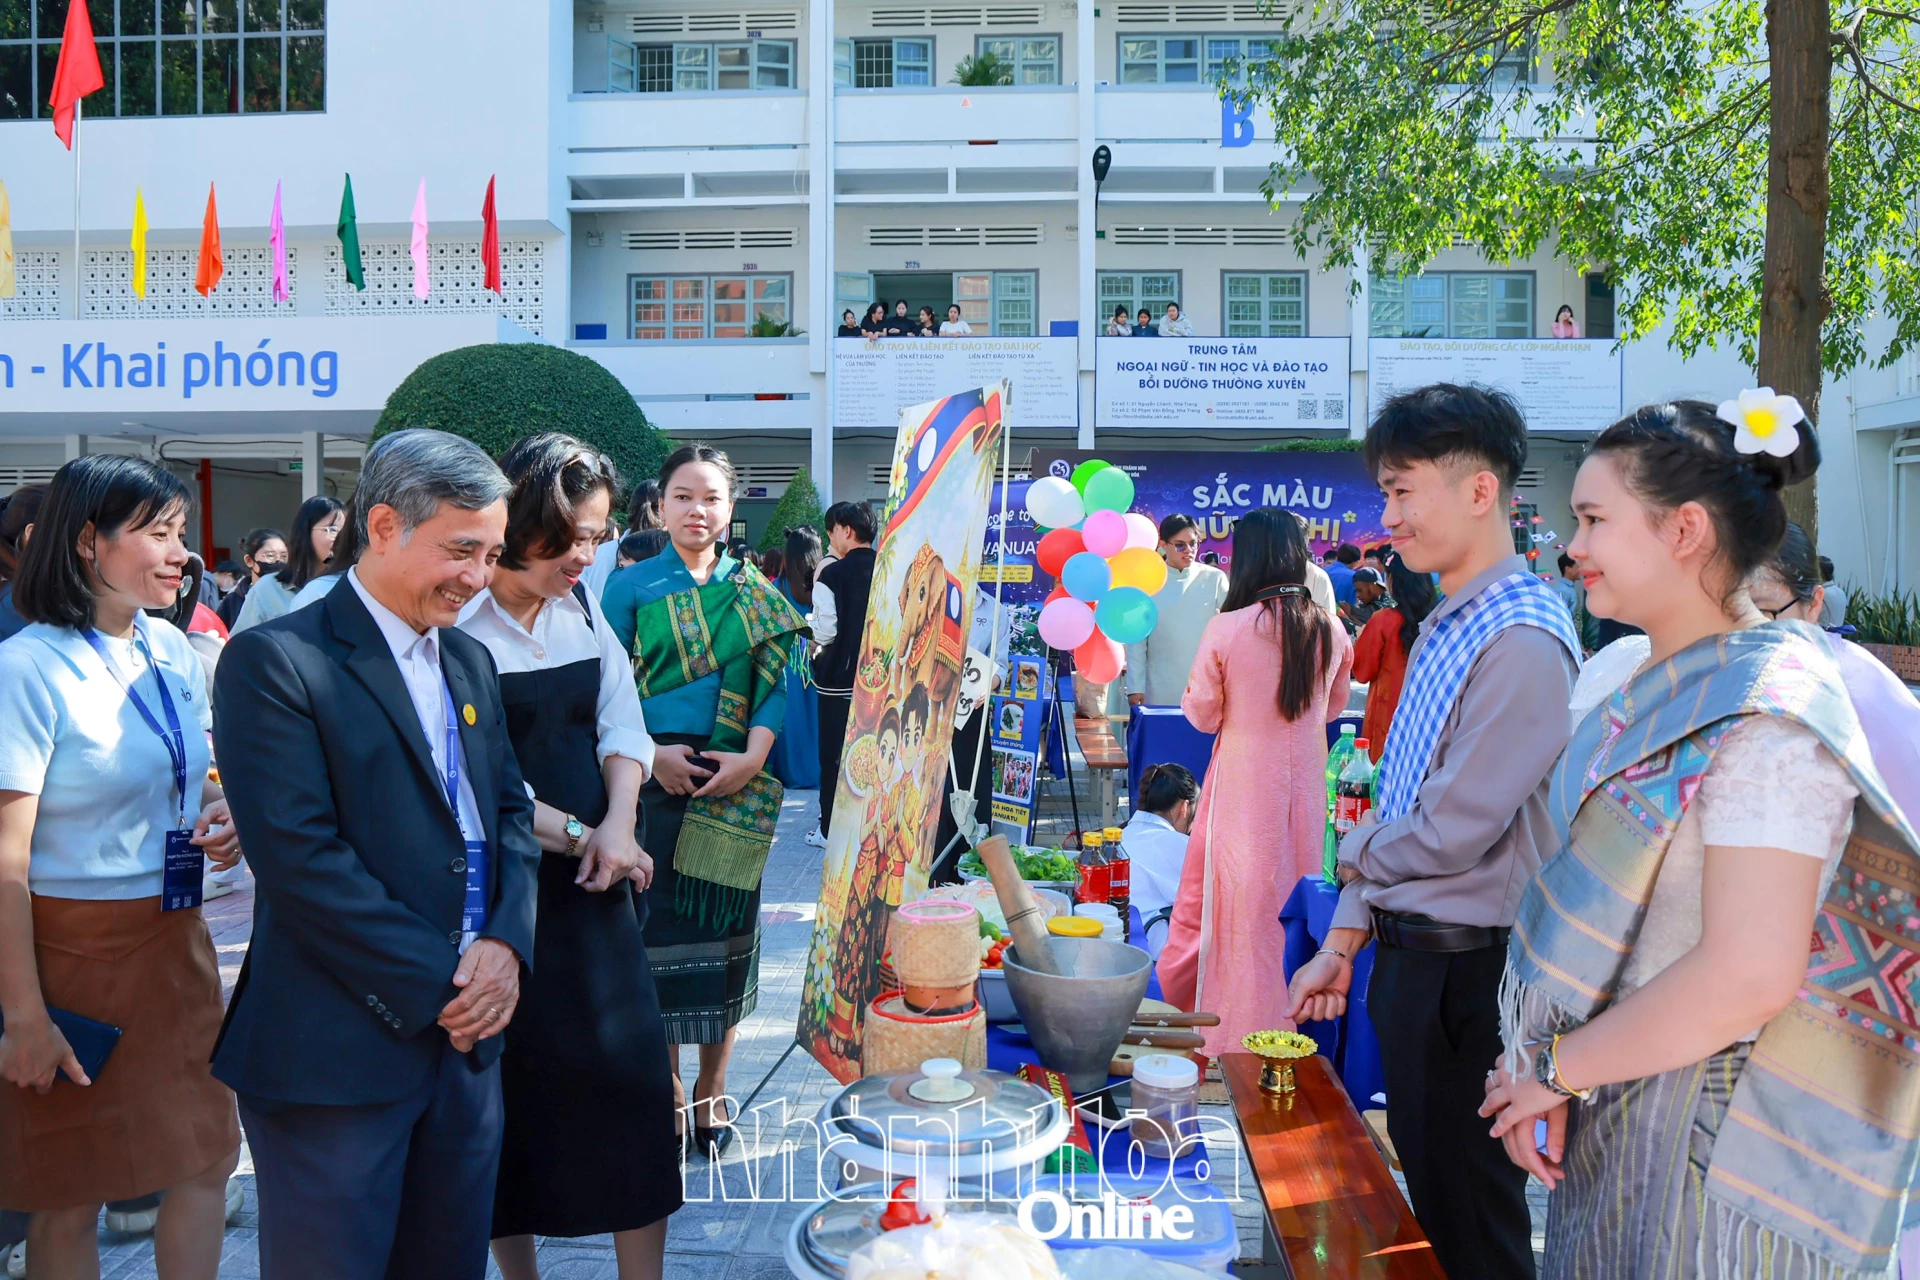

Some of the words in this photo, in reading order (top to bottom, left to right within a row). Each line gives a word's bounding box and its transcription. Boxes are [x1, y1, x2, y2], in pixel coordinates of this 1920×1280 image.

[1222, 92, 1254, 148] B
[864, 342, 884, 351] ĐÀO
[887, 342, 904, 352] TẠO
[907, 342, 918, 351] VÀ
[920, 342, 941, 351] LIÊN
[942, 340, 960, 351] KẾT
[962, 342, 982, 351] ĐÀO
[984, 342, 1002, 352] TẠO
[1004, 342, 1020, 352] ĐẠI
[1022, 342, 1042, 352] HỌC
[1188, 345, 1228, 355] TRUNG
[1232, 342, 1257, 355] TÂM
[63, 342, 165, 388] Khai
[184, 338, 338, 398] phóng
[1117, 362, 1158, 374] NGOẠI
[1161, 360, 1188, 372] NGỮ
[1198, 362, 1216, 372] TIN
[1220, 362, 1248, 374] HỌC
[1252, 360, 1269, 372] VÀ
[1272, 360, 1300, 372] ĐÀO
[1304, 362, 1328, 375] TẠO
[1138, 375, 1160, 389] BỒI
[1163, 376, 1208, 389] DƯỠNG
[1212, 376, 1263, 389] THƯỜNG
[1266, 376, 1306, 389] XUYÊN
[1192, 472, 1251, 508] SẮC
[1262, 478, 1333, 509] MÀU
[1019, 509, 1030, 522] to
